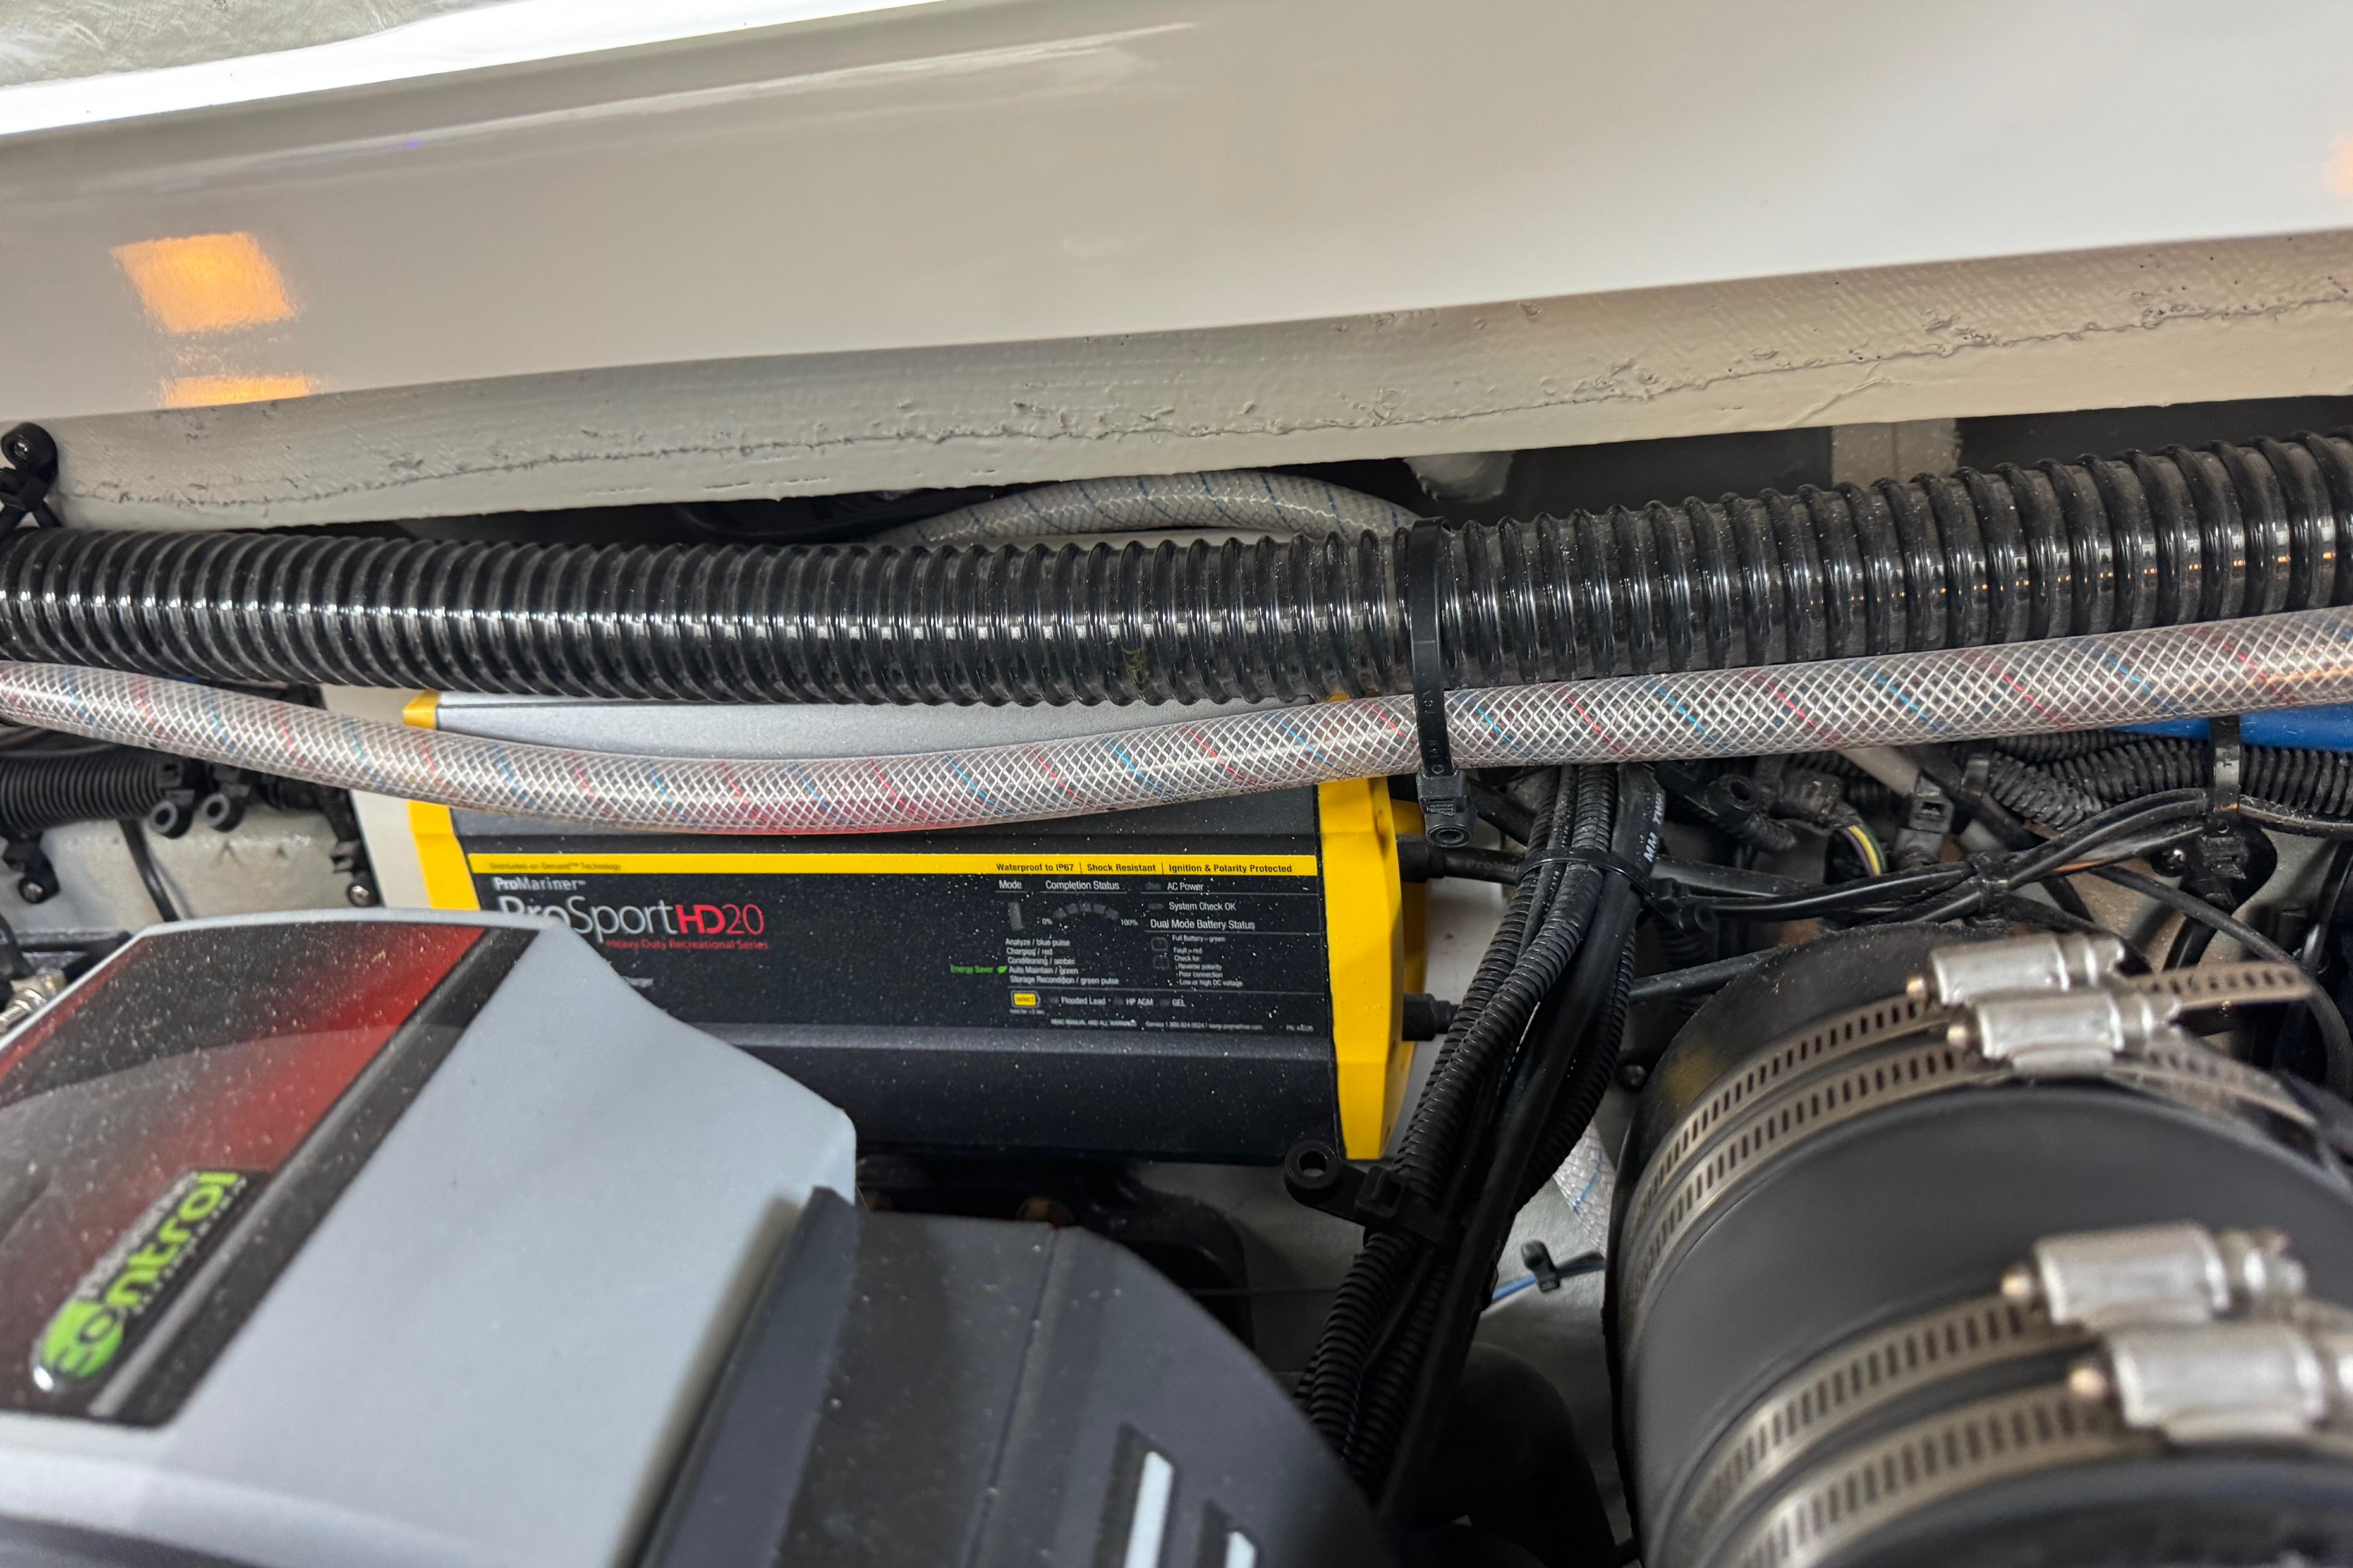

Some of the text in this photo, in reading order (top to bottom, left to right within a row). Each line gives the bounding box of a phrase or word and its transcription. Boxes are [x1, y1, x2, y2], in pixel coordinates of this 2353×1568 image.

[1643, 831, 1657, 863] MM
[997, 863, 1043, 872] Waterproof
[1087, 863, 1156, 872] Shock Resistant
[1169, 864, 1202, 873] Ignition
[1214, 865, 1246, 873] Polarity
[999, 880, 1022, 889] Mode
[1045, 880, 1120, 890] Completion Status
[1167, 882, 1204, 890] AC Power
[1169, 901, 1236, 911] System Check OK
[1150, 919, 1255, 930] Dual Mode Battery Status
[641, 939, 667, 950] Duty
[669, 939, 735, 950] Recreational
[736, 939, 769, 950] Series
[1005, 938, 1031, 947] Analyze
[1006, 947, 1036, 956] Charging
[1008, 956, 1048, 966] Conditioning
[1010, 976, 1035, 984] Storage
[1061, 996, 1088, 1005] Flooded
[1089, 996, 1106, 1005] Lead
